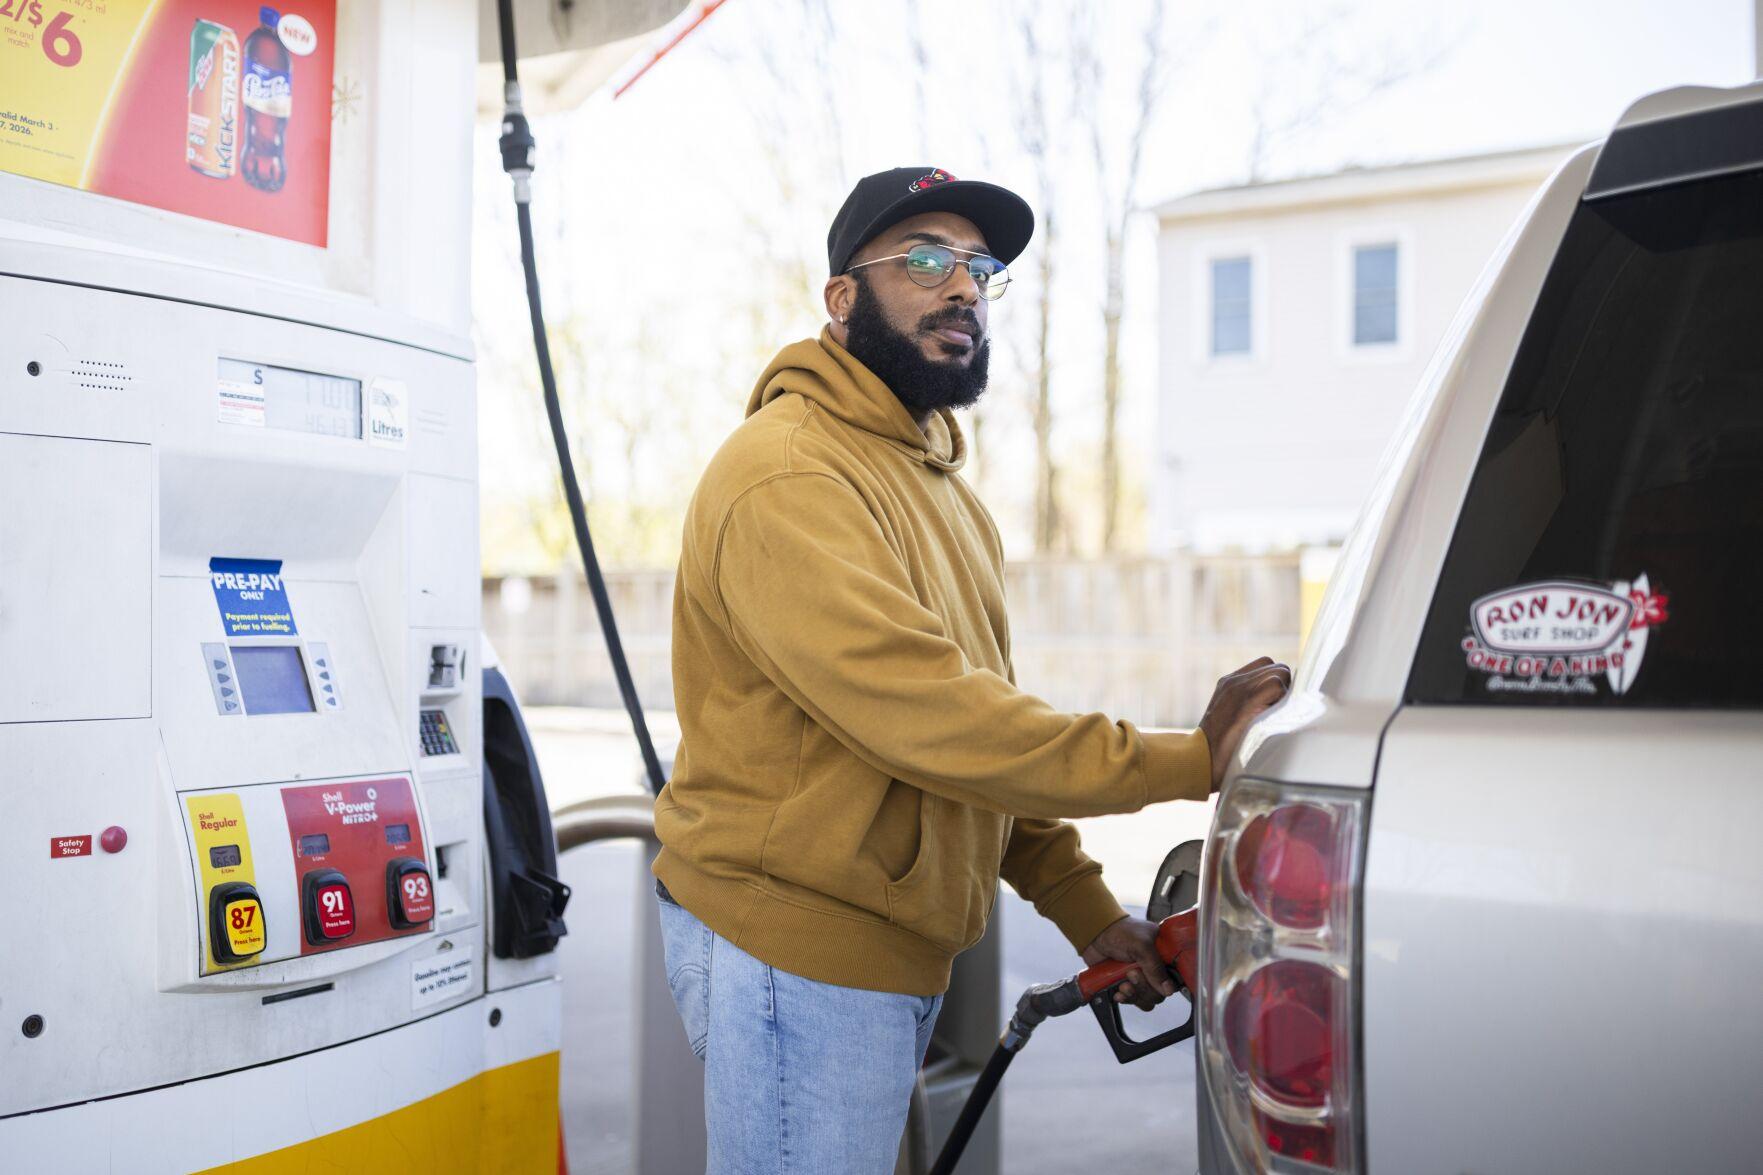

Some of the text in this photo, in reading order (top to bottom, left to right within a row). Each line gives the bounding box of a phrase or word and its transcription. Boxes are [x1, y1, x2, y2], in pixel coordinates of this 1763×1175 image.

[19, 31, 34, 40] and
[20, 115, 46, 128] March
[9, 123, 34, 136] 2026.
[372, 419, 404, 438] Litres
[213, 572, 281, 591] PRE-PAY
[240, 590, 265, 601] ONLY
[225, 612, 291, 622] Payment required
[1486, 594, 1620, 629] RON JON
[231, 623, 251, 632] prior
[251, 623, 260, 631] to
[1501, 627, 1602, 641] SURF SHOP
[1470, 651, 1512, 673] ONE
[1516, 655, 1548, 676] OF
[1550, 656, 1567, 675] A
[322, 791, 344, 802] Shell
[324, 801, 377, 815] V-Power
[198, 812, 214, 821] Shell
[200, 817, 238, 831] Regular
[403, 876, 428, 900] 93
[322, 890, 344, 913] 91
[231, 905, 256, 930] 87
